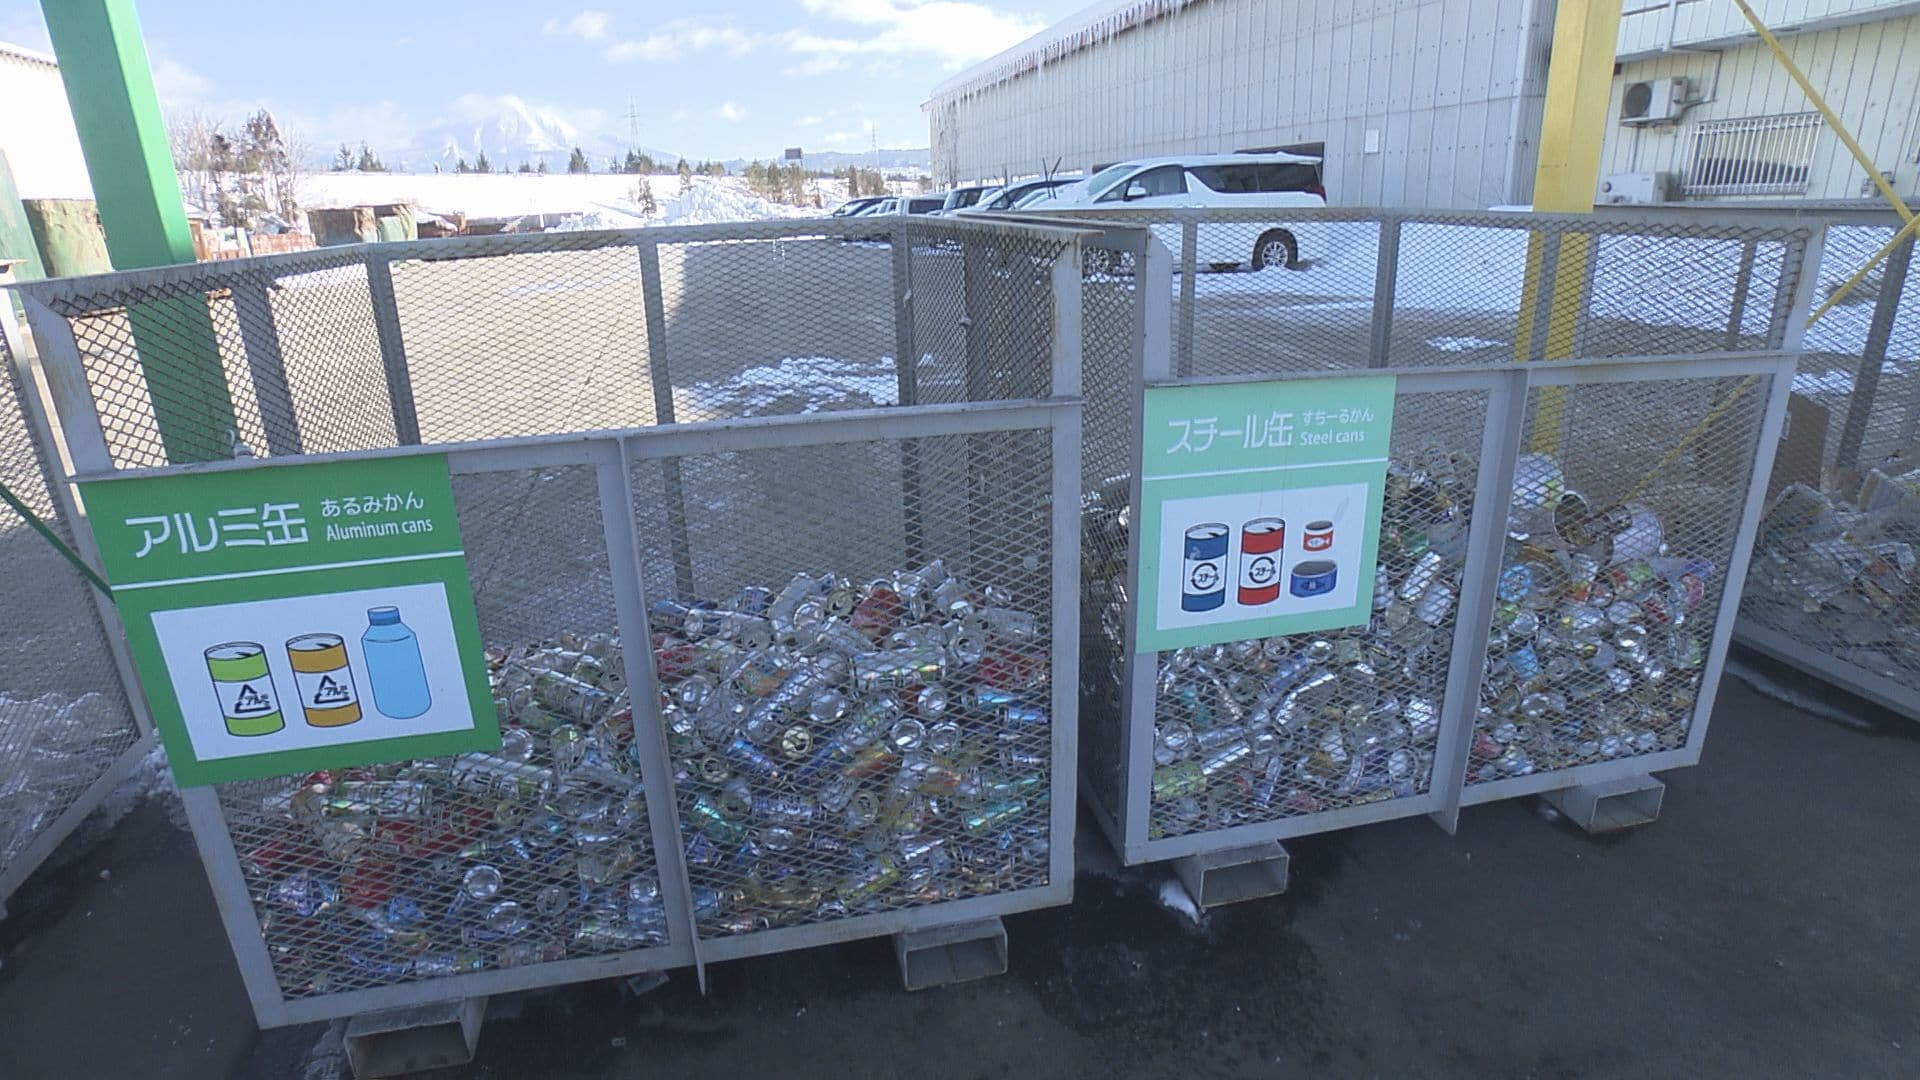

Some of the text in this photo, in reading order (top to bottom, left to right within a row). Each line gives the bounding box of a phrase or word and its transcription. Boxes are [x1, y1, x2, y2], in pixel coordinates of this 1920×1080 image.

[1302, 408, 1374, 426] すちーるかん
[1166, 411, 1294, 454] スチール缶
[1299, 429, 1366, 446] Steel cans
[320, 491, 424, 518] あるみかん
[125, 502, 309, 559] アルミ缶
[326, 517, 433, 542] Aluminum cans
